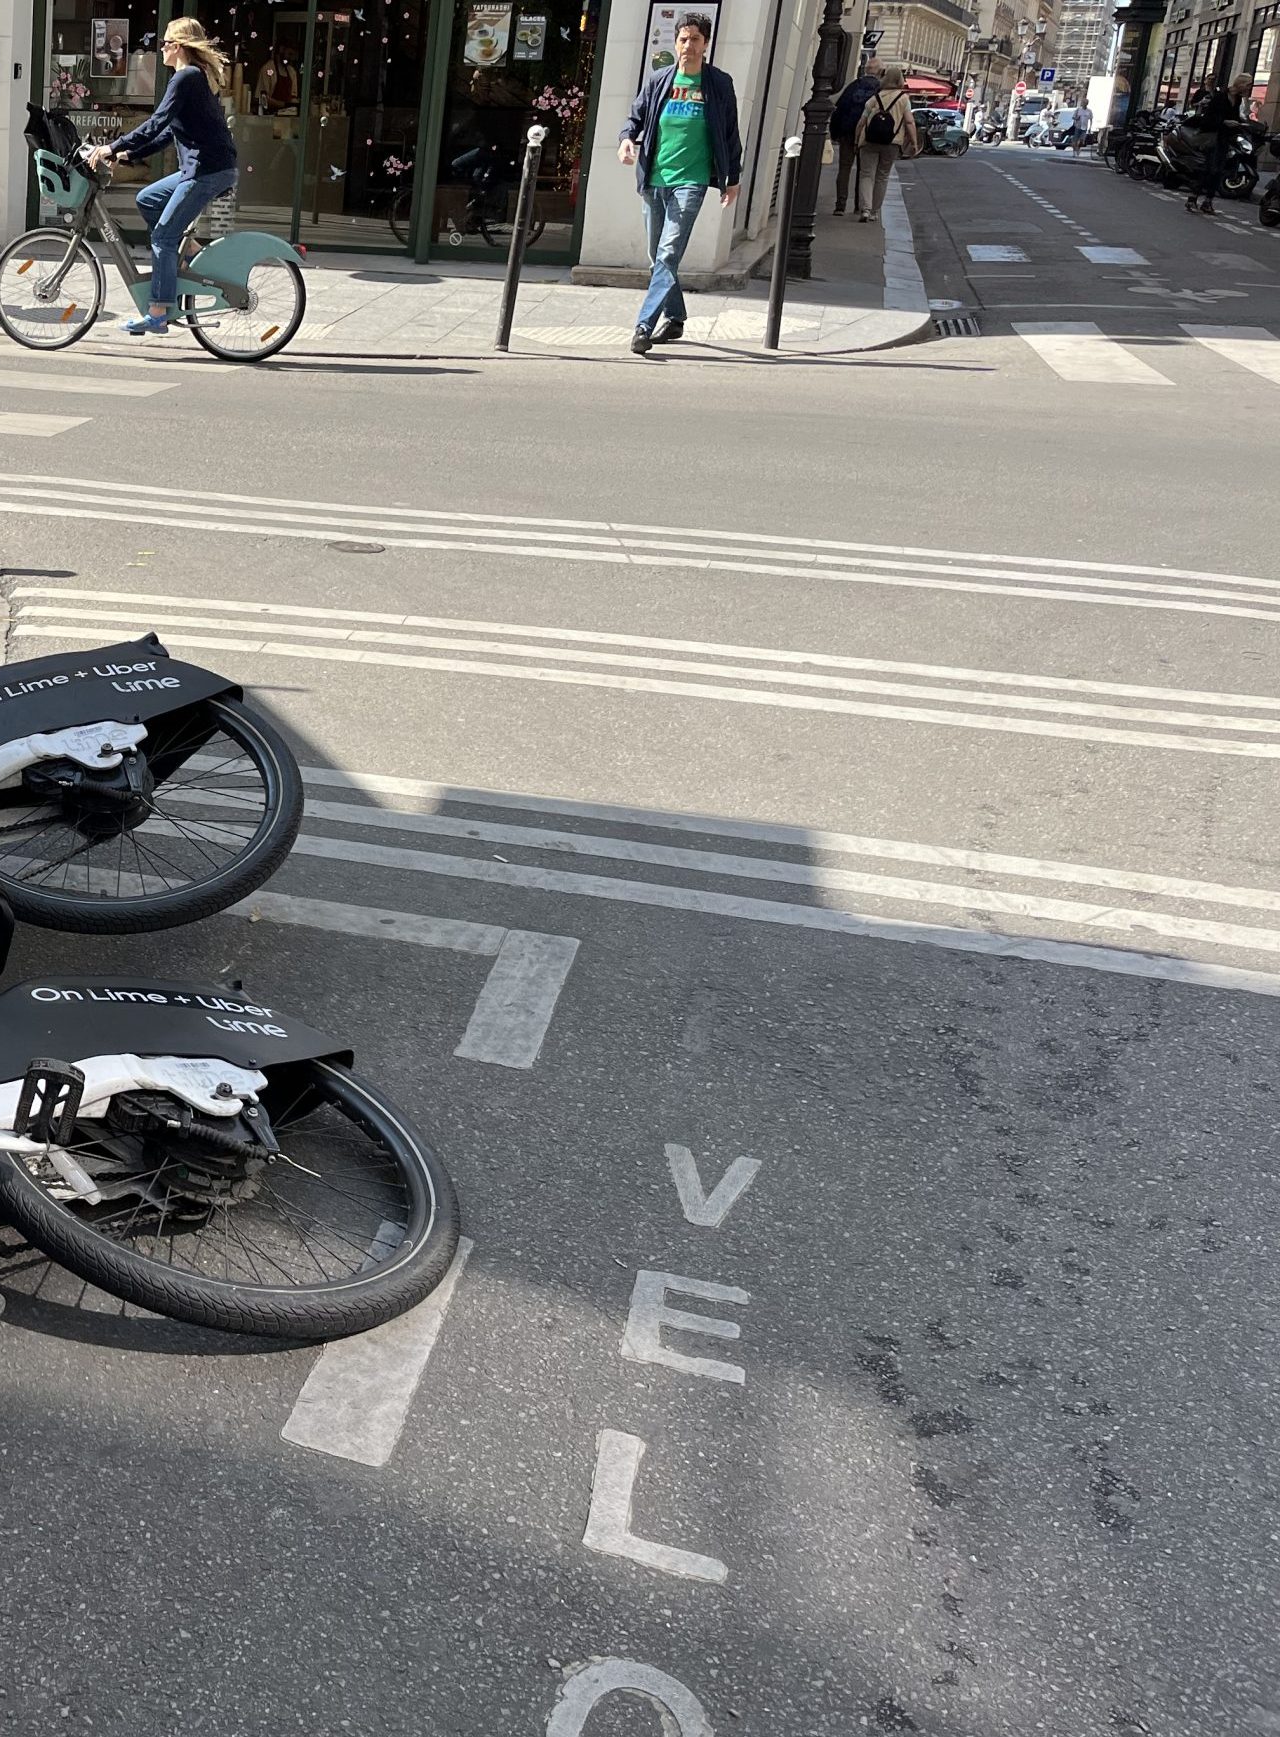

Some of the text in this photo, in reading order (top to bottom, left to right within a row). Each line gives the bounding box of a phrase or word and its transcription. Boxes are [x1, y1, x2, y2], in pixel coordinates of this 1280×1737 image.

[3, 674, 70, 698] Lime
[92, 661, 158, 678] Uber
[30, 987, 84, 1002] On
[86, 988, 169, 1005] Lime
[195, 995, 274, 1018] Uber
